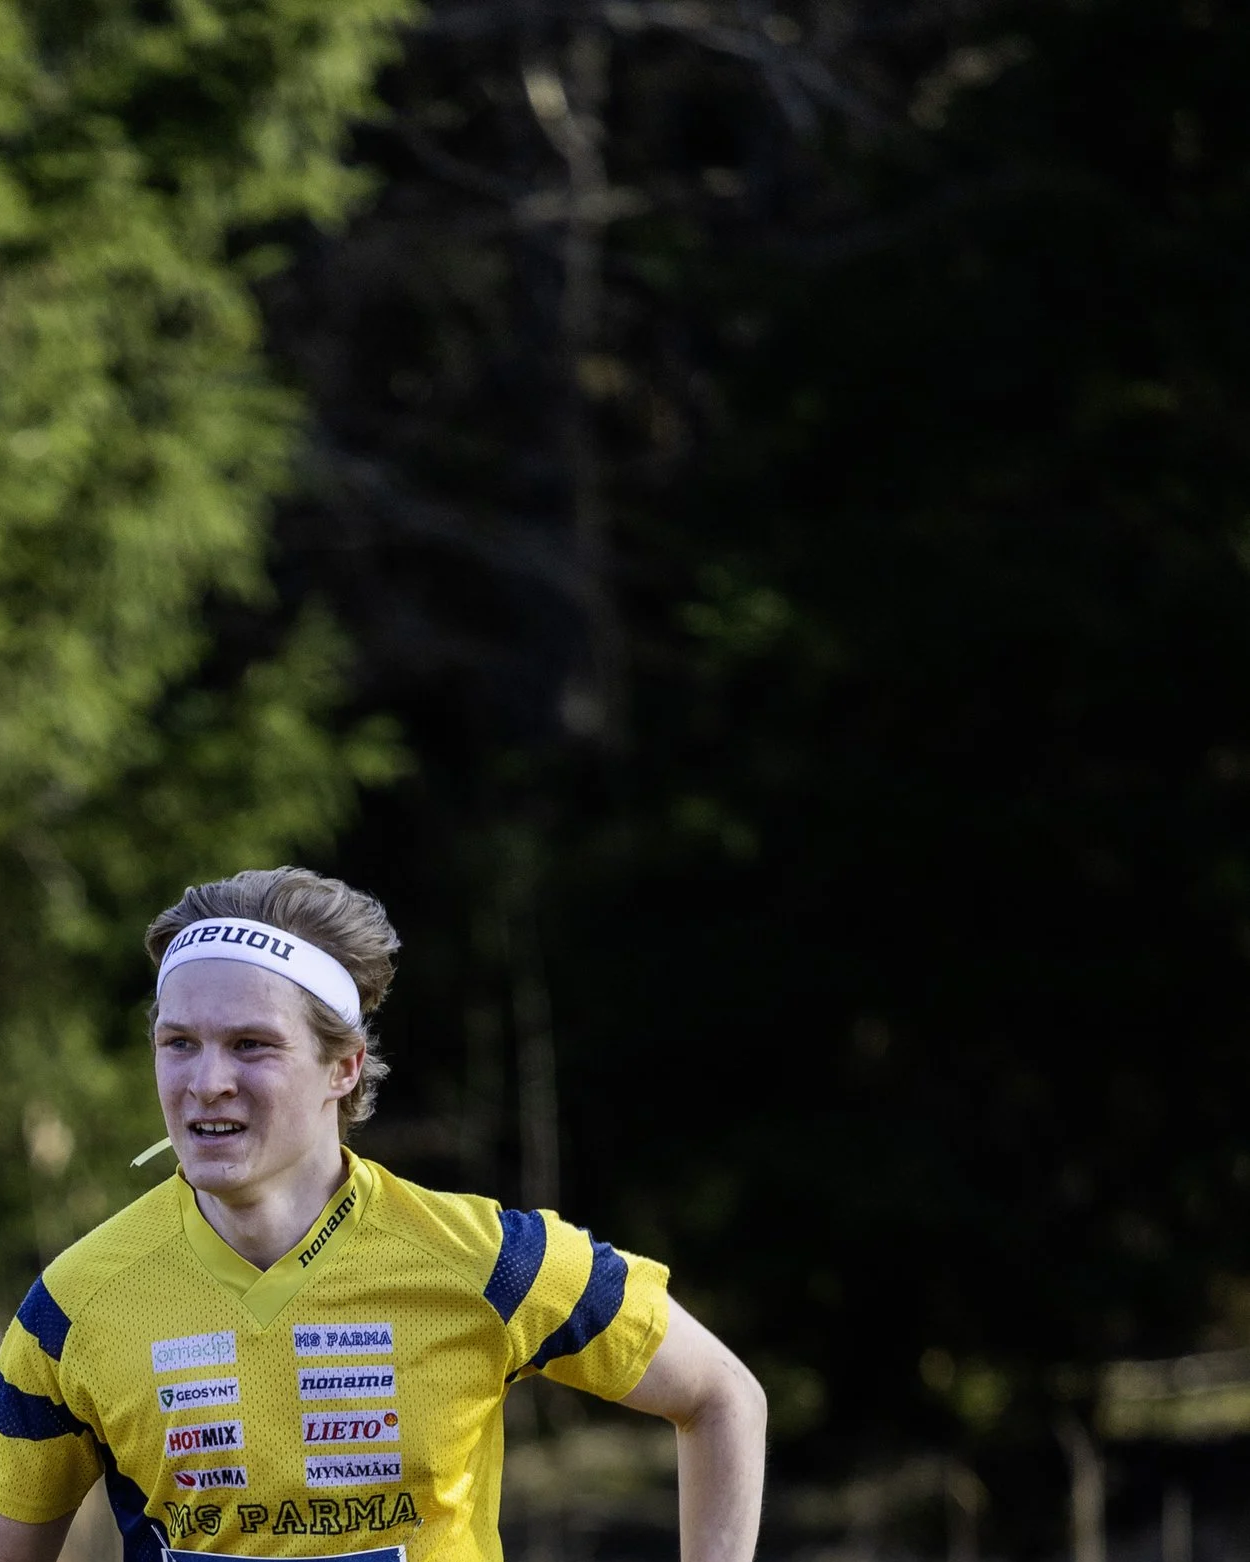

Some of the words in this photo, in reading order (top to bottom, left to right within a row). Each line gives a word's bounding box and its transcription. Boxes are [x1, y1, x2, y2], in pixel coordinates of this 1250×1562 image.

[295, 1333, 320, 1347] MS
[327, 1331, 392, 1346] PARMA
[301, 1375, 393, 1390] noname
[176, 1384, 237, 1401] GEOSYNT
[168, 1426, 238, 1451] HOTMIX
[305, 1419, 381, 1442] LIETO
[198, 1469, 246, 1488] VISMA
[306, 1462, 401, 1481] MYNÄMÄKI
[164, 1502, 222, 1538] MS
[238, 1493, 417, 1535] PARMA
